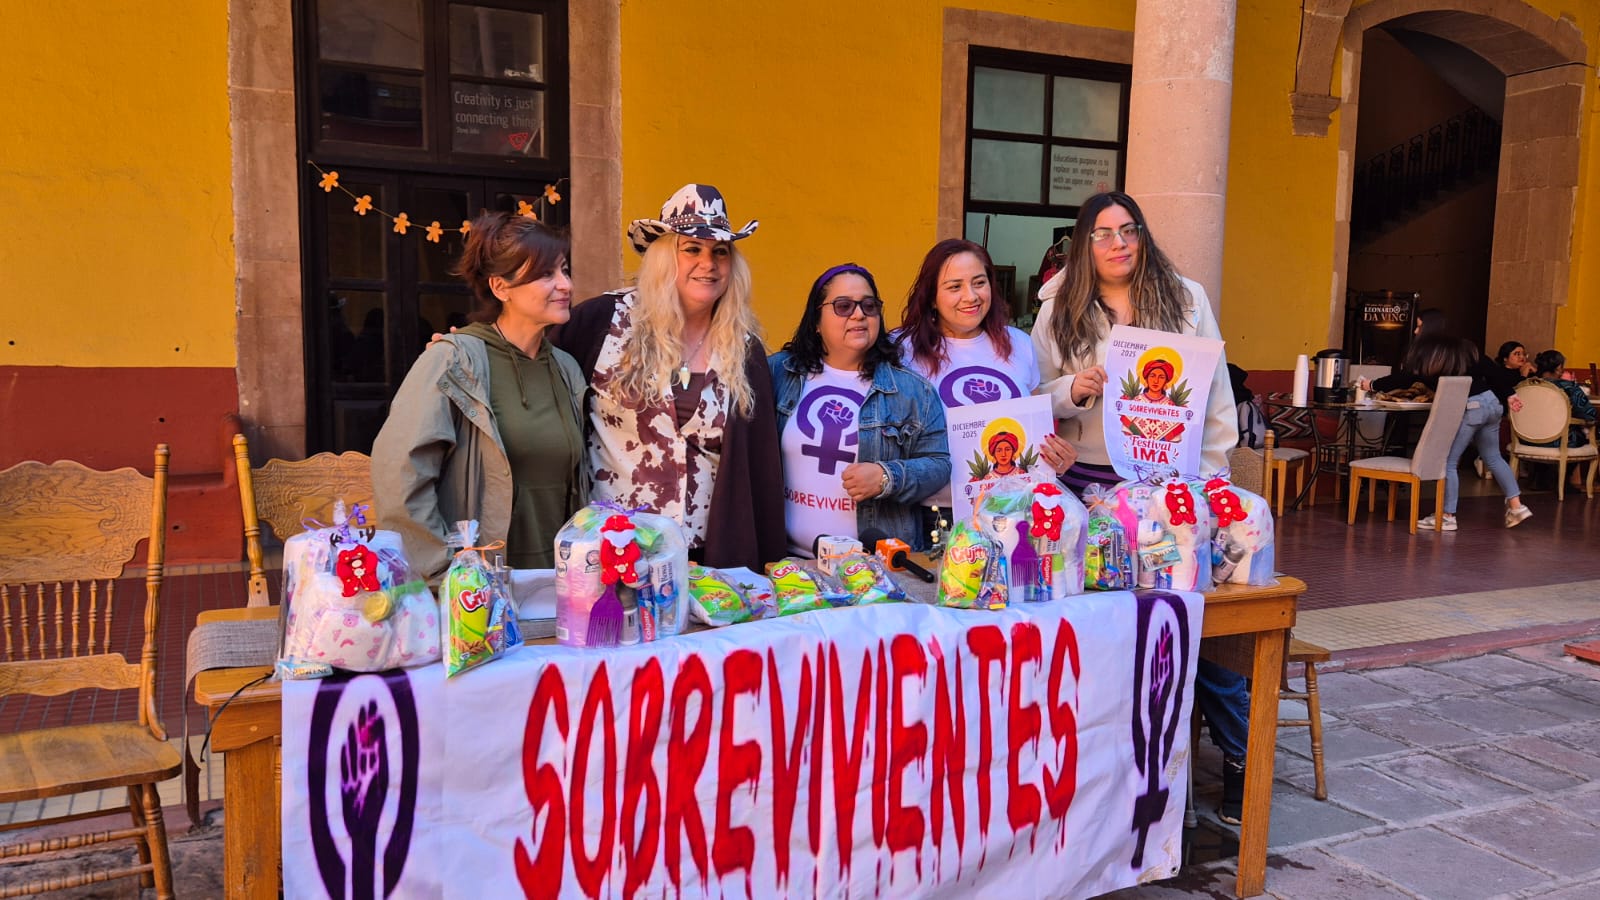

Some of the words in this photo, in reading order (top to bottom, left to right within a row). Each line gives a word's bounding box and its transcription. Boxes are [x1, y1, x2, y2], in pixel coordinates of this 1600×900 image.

[454, 91, 501, 110] Creativity
[504, 95, 514, 108] is
[514, 96, 534, 111] just
[455, 112, 509, 129] connecting
[511, 114, 541, 129] thing
[1364, 305, 1401, 314] LEONARDO
[1364, 312, 1378, 321] DA
[1113, 340, 1148, 351] DICIEMBRE
[1120, 350, 1136, 358] 2025
[1129, 403, 1180, 417] SOBREVIVIENTES
[952, 420, 986, 431] DICIEMBRE
[962, 430, 977, 439] 2025
[1130, 435, 1171, 452] Festival
[644, 609, 652, 641] Colgate
[514, 616, 1080, 900] SOBREVIVIENTES
